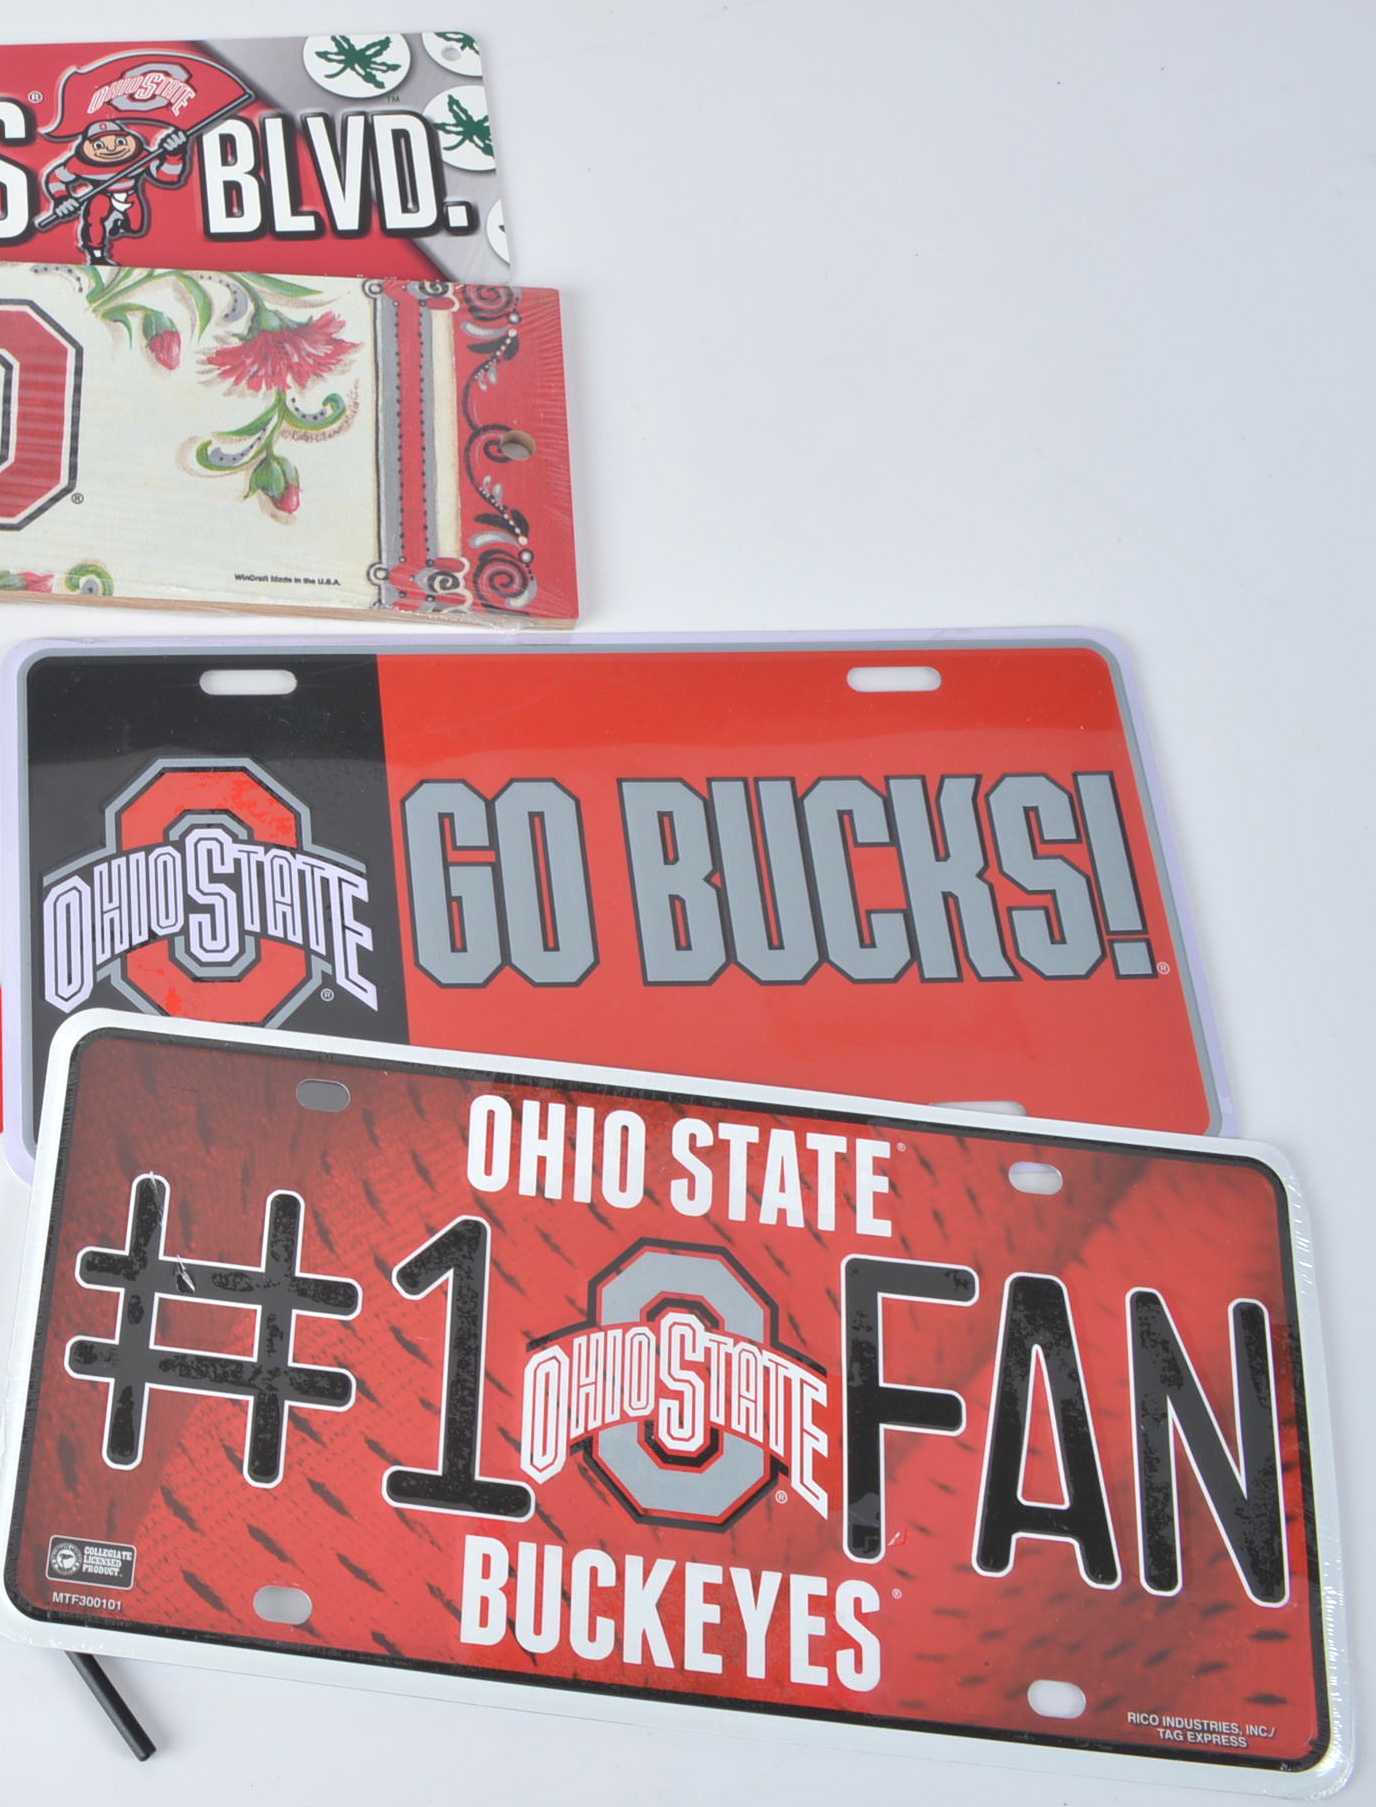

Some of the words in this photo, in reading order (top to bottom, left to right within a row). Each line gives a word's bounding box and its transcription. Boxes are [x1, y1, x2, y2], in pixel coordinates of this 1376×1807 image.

[200, 110, 474, 237] BLVD.
[401, 777, 600, 989] GO
[616, 771, 1158, 986] BUCKS!
[467, 1094, 647, 1209] OHIO
[670, 1117, 892, 1237] STATE
[64, 1172, 535, 1522] #1
[841, 1253, 1290, 1608] FAN
[83, 1555, 122, 1568] LICENSED
[84, 1546, 132, 1560] COLLEGIATE
[52, 1592, 122, 1611] MTF300101
[459, 1534, 881, 1692] BUCKEYES
[1127, 1711, 1159, 1726] RICO
[1162, 1716, 1243, 1736] INDUSTRIES,
[1157, 1728, 1184, 1741] TAG
[1187, 1732, 1248, 1748] EXPRESS
